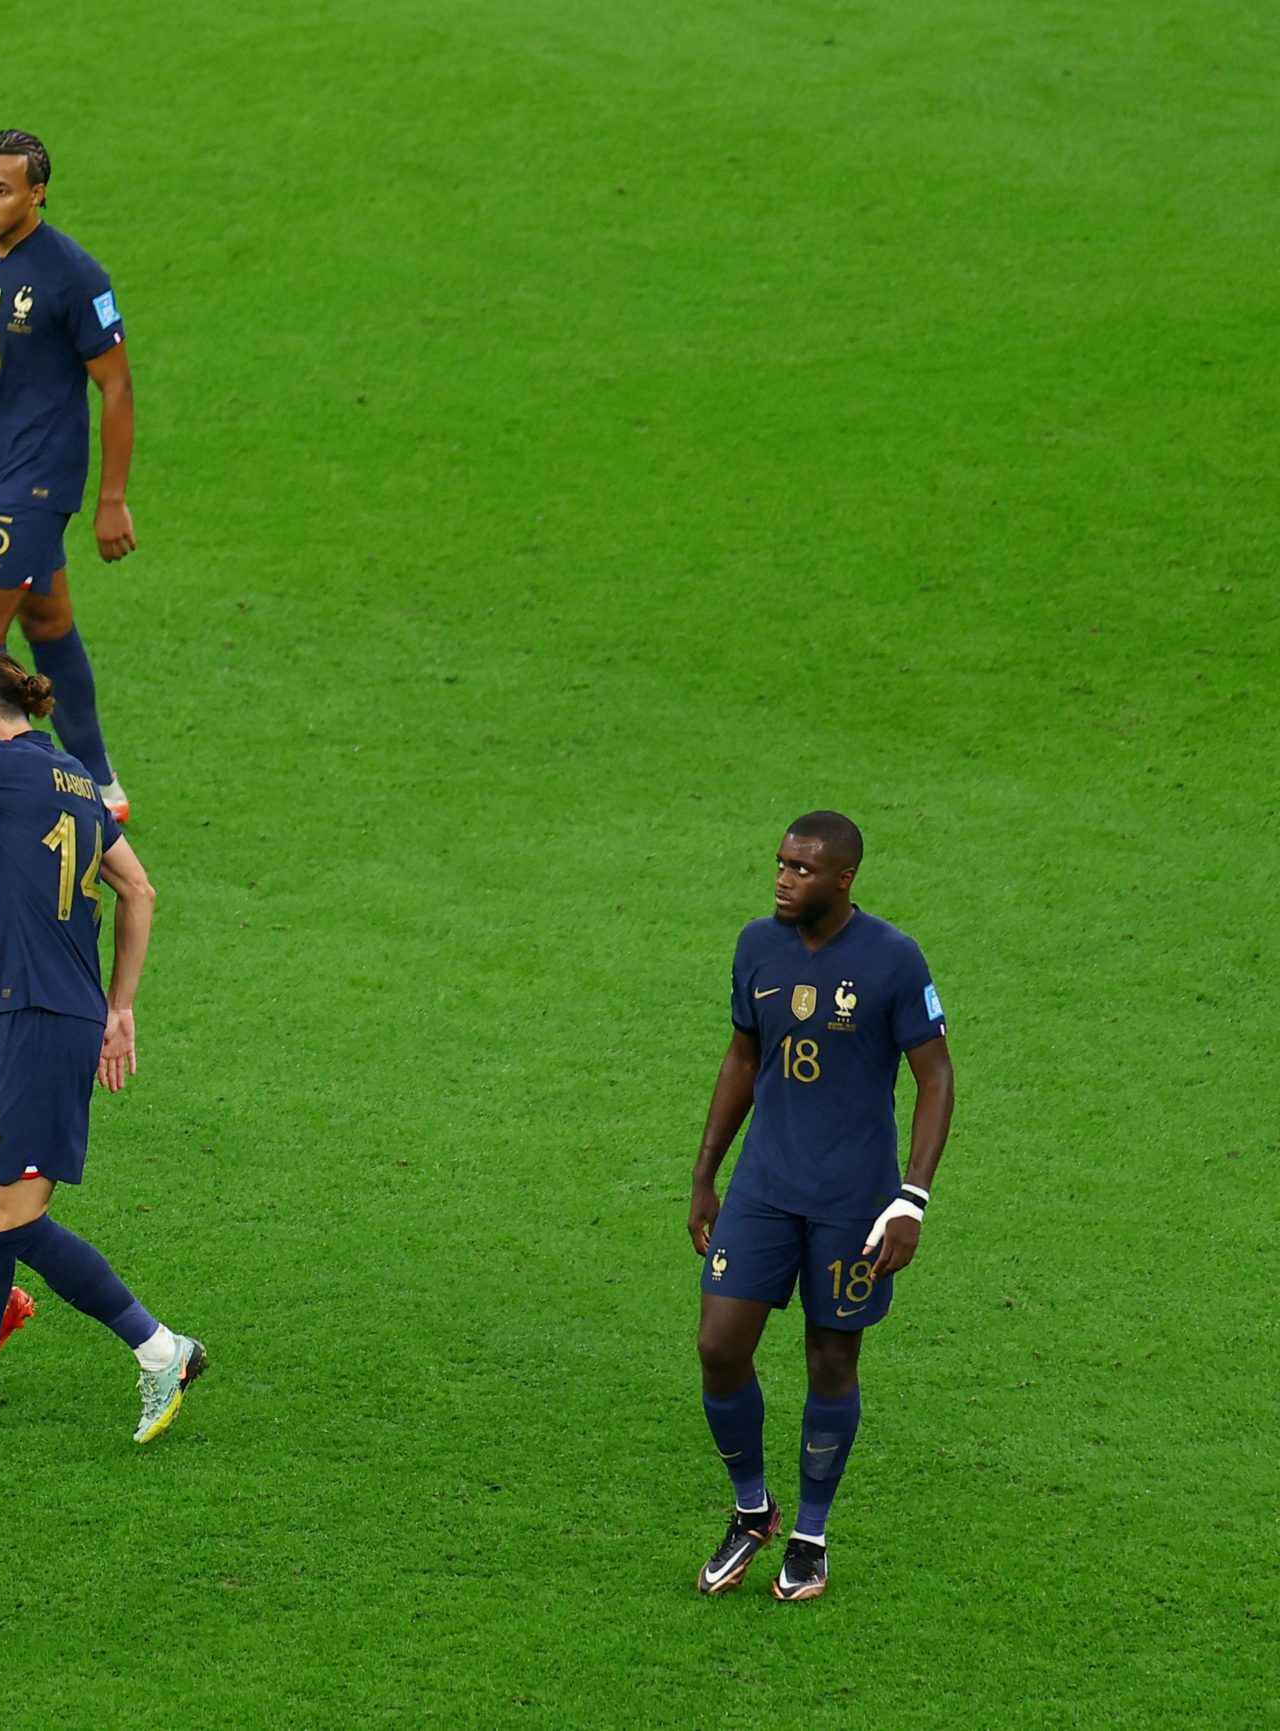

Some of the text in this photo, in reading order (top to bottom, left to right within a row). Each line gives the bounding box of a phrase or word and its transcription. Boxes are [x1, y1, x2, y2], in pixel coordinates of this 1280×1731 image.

[52, 767, 97, 801] RABIOT
[42, 810, 104, 922] 14
[780, 1035, 822, 1083] 18
[826, 1258, 874, 1303] 18
